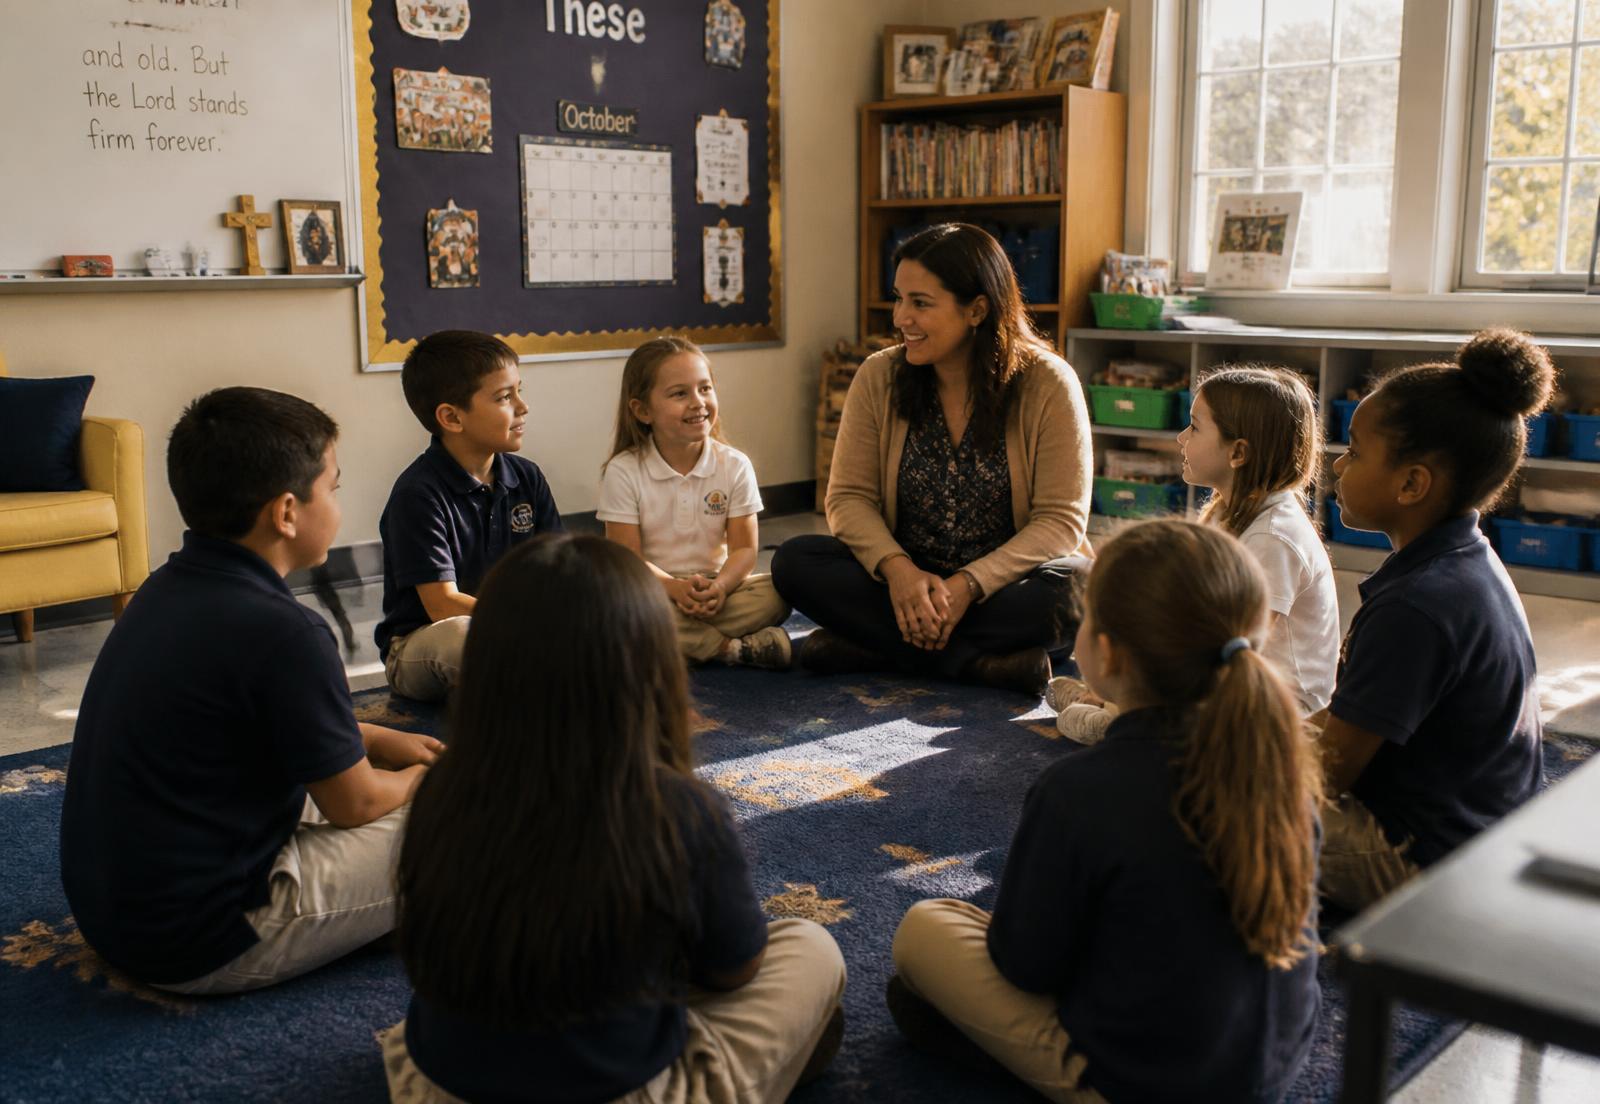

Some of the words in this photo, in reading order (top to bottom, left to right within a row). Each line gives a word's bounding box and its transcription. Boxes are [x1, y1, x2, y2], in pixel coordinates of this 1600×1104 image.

[82, 41, 124, 69] and
[137, 44, 178, 72] old.
[191, 45, 230, 75] But
[83, 81, 121, 109] the
[132, 82, 177, 111] Lord
[188, 88, 249, 116] stands
[87, 118, 135, 151] firm
[145, 122, 222, 152] forever.
[564, 104, 635, 133] October
